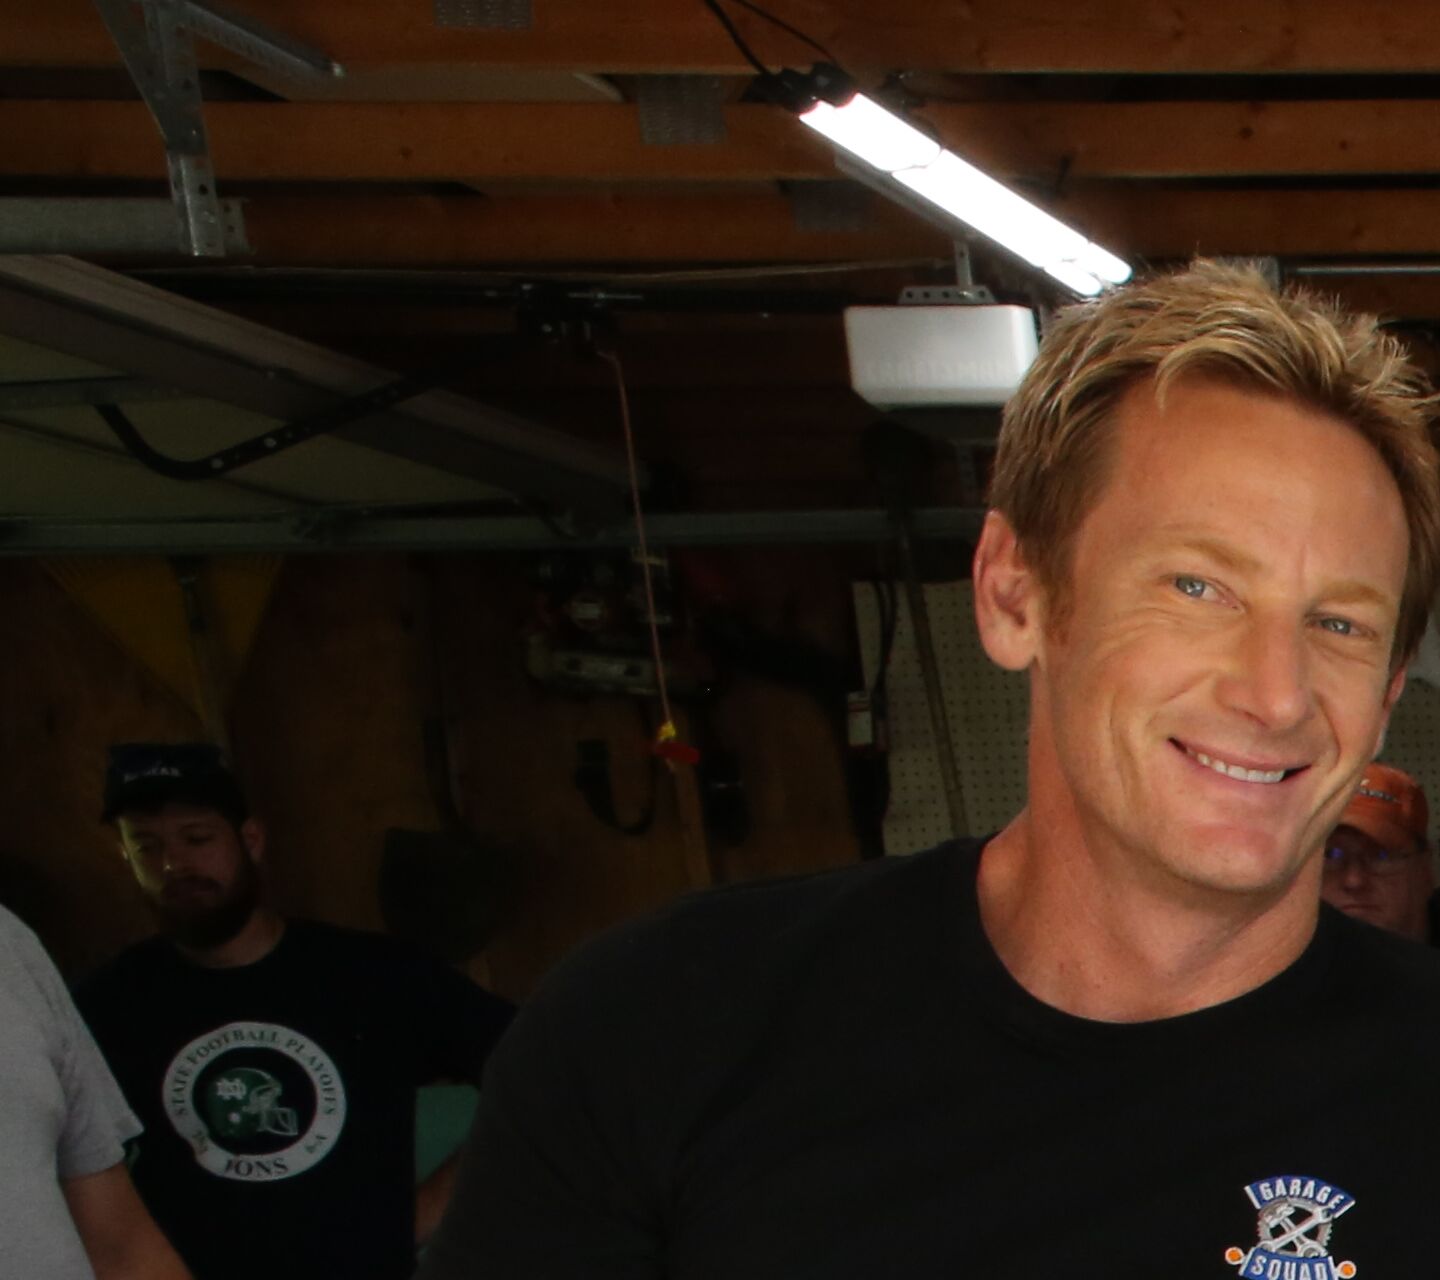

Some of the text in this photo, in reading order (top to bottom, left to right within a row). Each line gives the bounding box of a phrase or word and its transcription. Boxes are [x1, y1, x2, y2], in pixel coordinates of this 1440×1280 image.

[171, 1066, 189, 1116] STATE
[187, 1029, 281, 1065] FOOTBALL
[286, 1039, 337, 1115] PLAYOFFS
[1258, 1178, 1345, 1210] GARAGE
